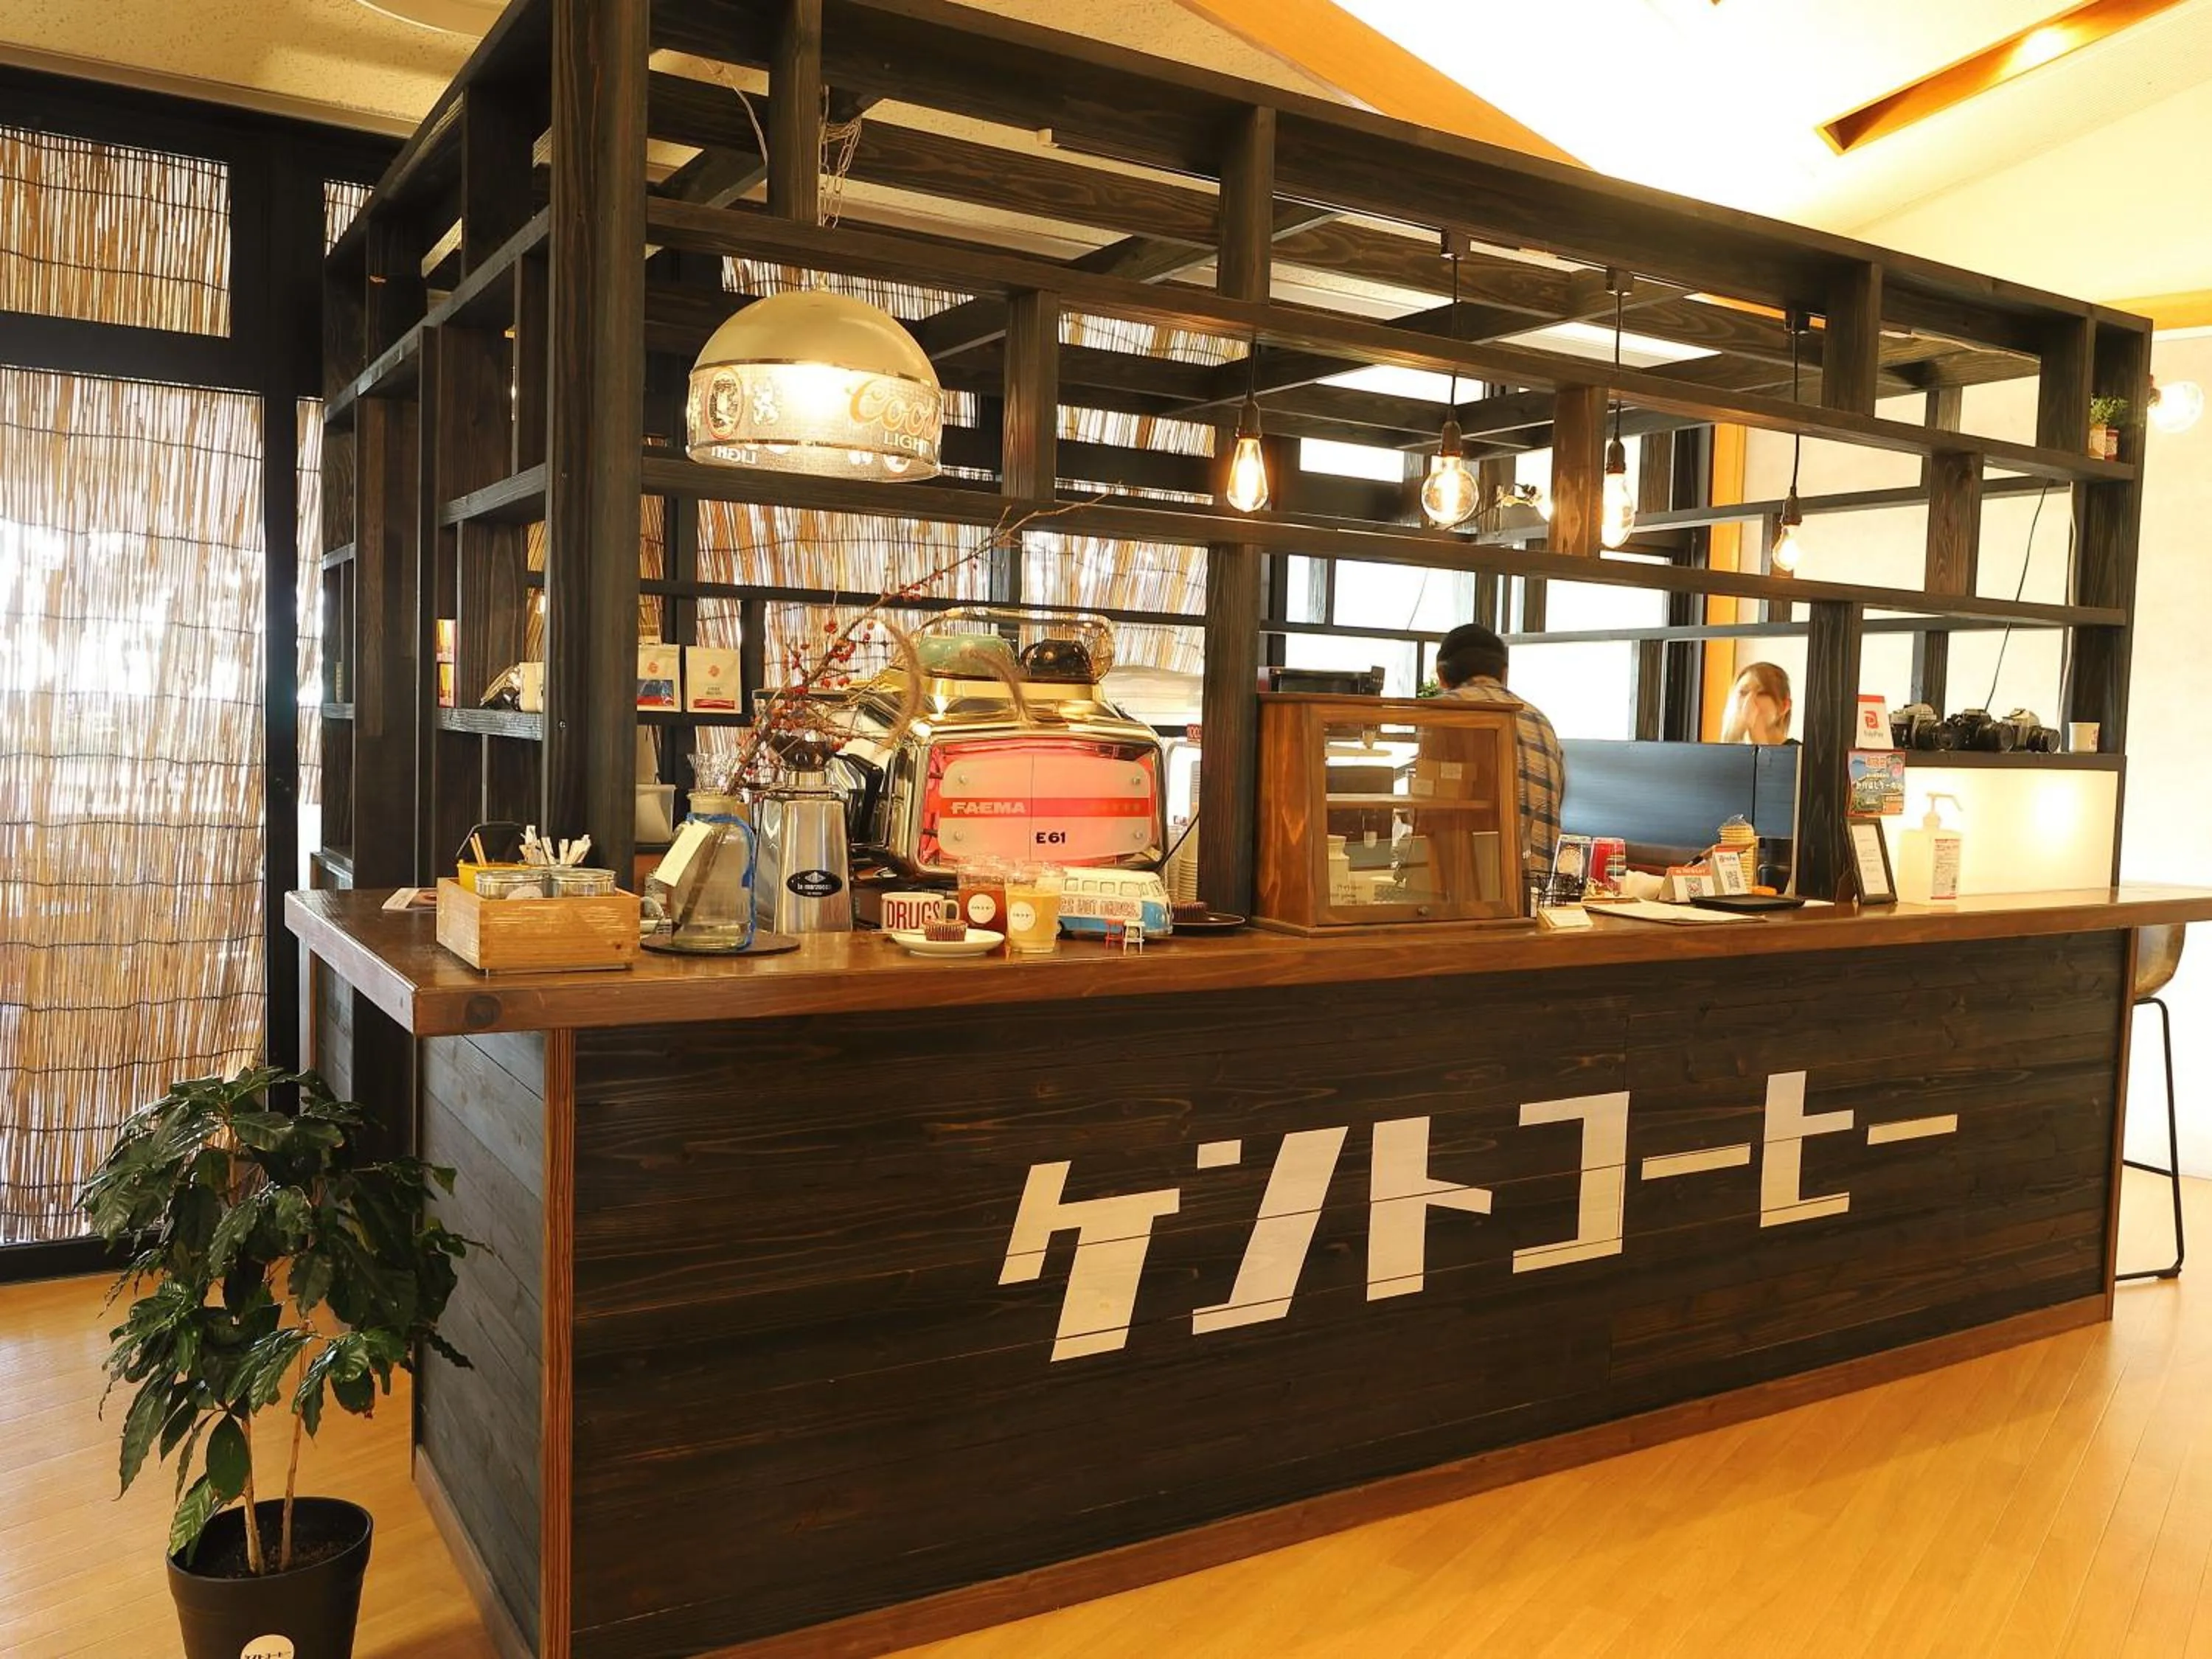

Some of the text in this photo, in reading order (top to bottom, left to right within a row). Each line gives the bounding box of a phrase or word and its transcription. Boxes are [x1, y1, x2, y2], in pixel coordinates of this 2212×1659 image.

[884, 431, 929, 455] LIGHT
[951, 801, 1026, 815] FAEMA
[886, 900, 941, 930] DRUGS
[998, 1071, 1958, 1362] ケントコーヒー
